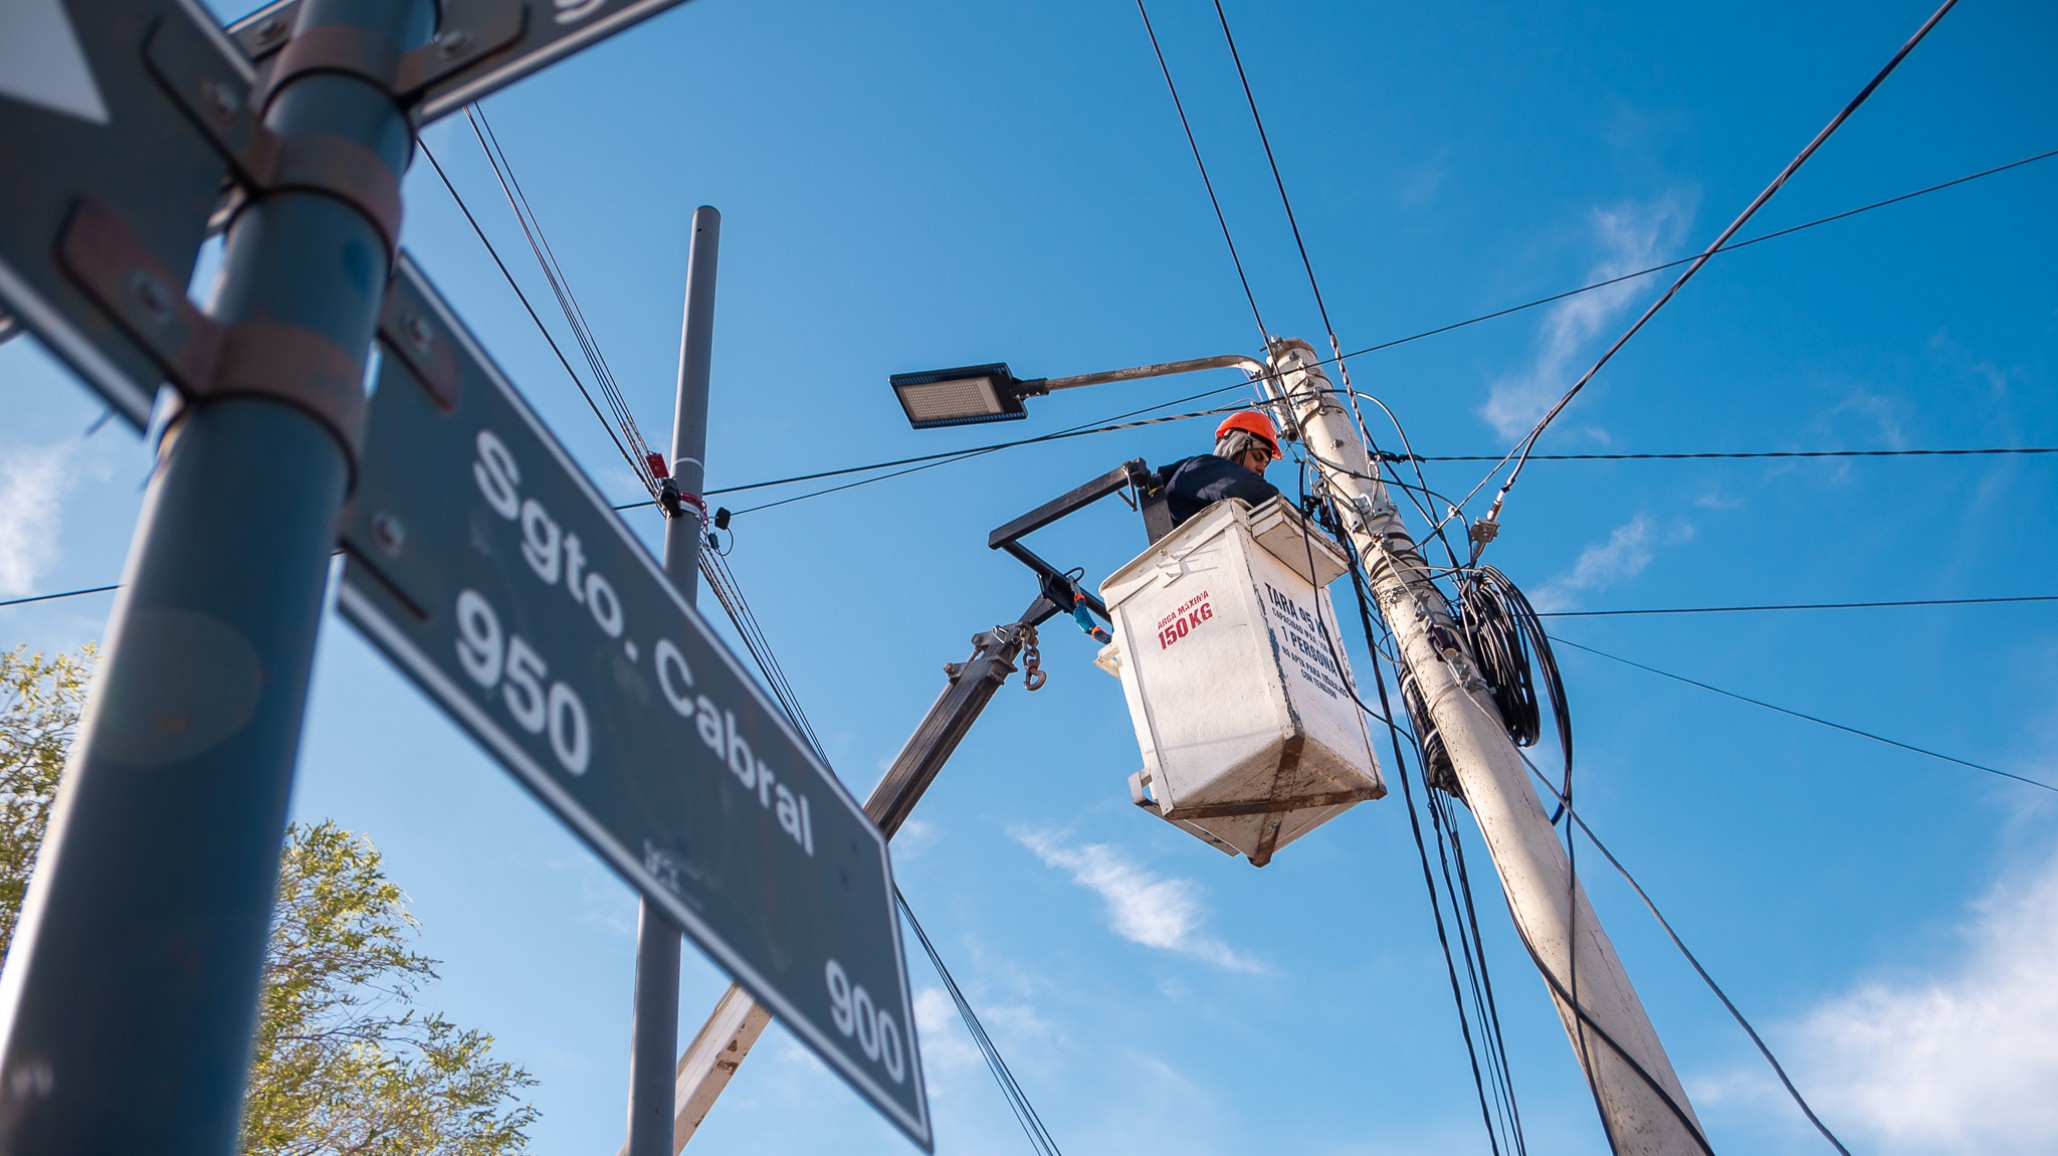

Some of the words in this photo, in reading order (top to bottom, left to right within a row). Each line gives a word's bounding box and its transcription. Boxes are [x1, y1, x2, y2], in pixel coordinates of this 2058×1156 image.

[1158, 618, 1189, 650] 150
[1188, 602, 1213, 630] KG
[1264, 582, 1299, 621] TARA
[473, 430, 638, 661] Sgto.
[654, 638, 814, 856] Cabral
[1281, 626, 1289, 642] 1
[1289, 630, 1338, 678] PERSONA
[456, 590, 590, 775] 950
[1300, 669, 1313, 684] CON
[1305, 662, 1321, 679] PARA
[825, 958, 906, 1084] 900
